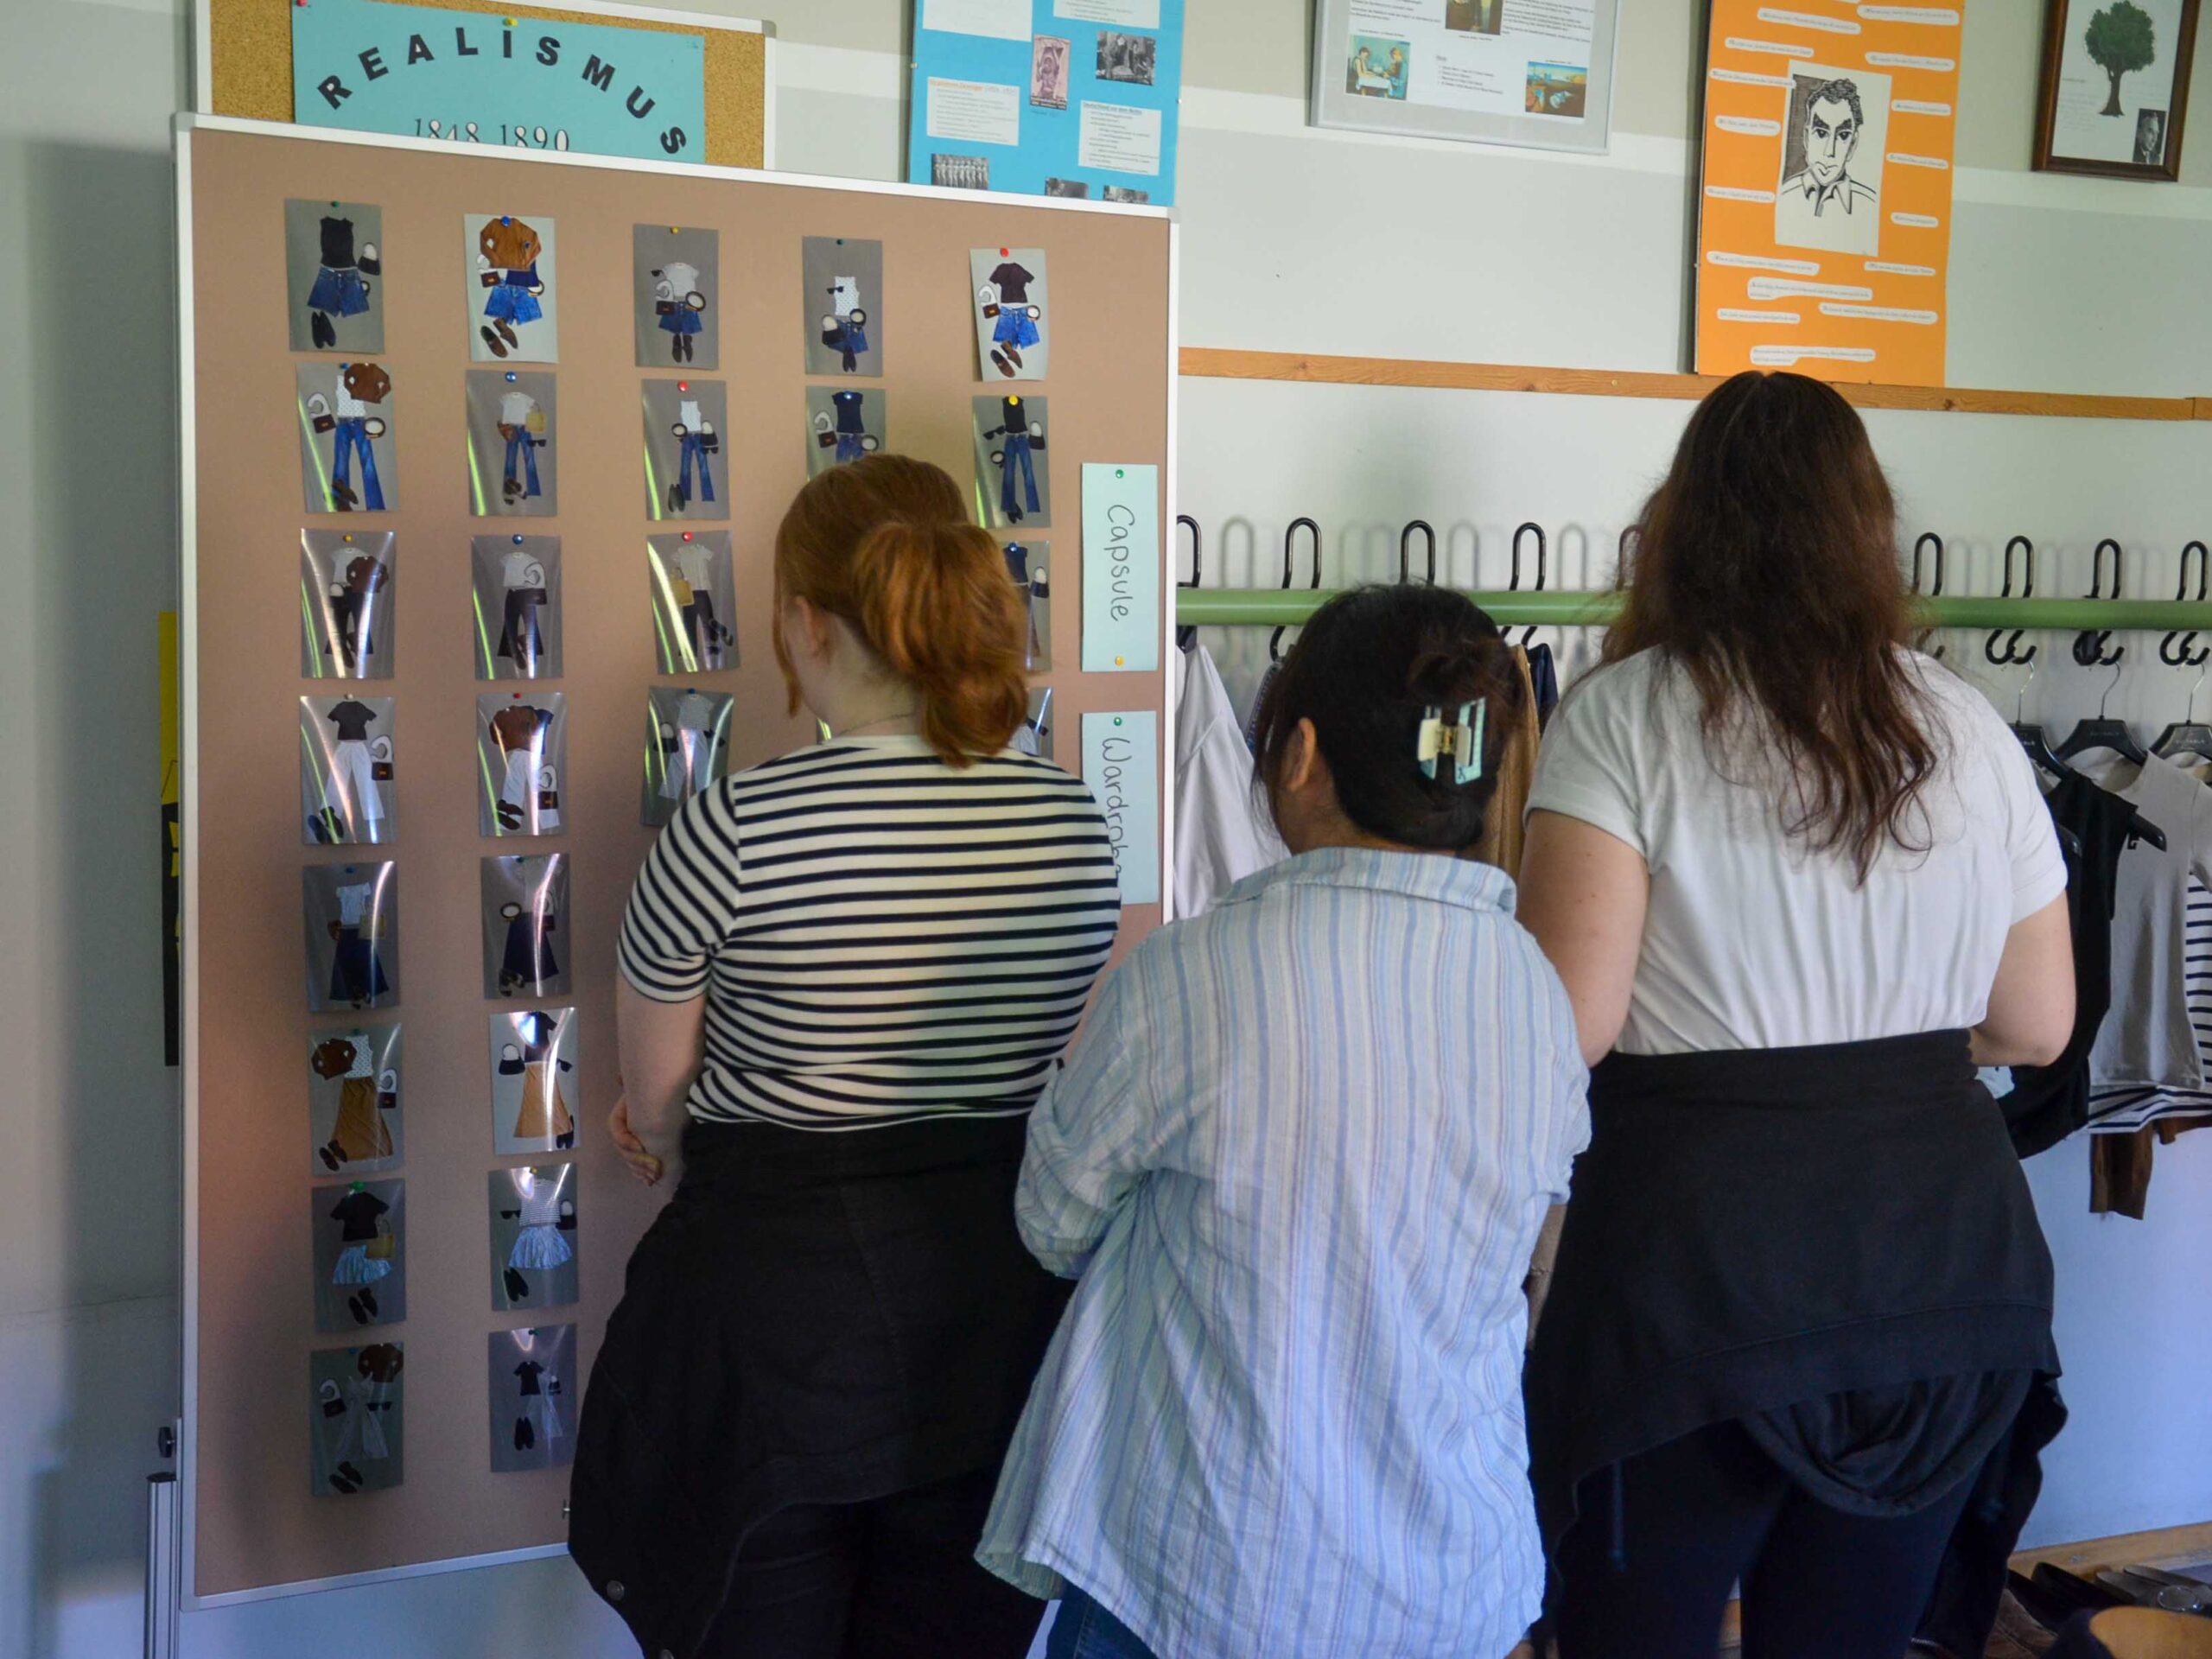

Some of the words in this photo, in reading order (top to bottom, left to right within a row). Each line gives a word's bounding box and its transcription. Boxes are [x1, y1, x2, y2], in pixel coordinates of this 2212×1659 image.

[317, 27, 687, 155] REALISMUS
[500, 124, 569, 151] 1890
[1103, 504, 1135, 623] Capsule
